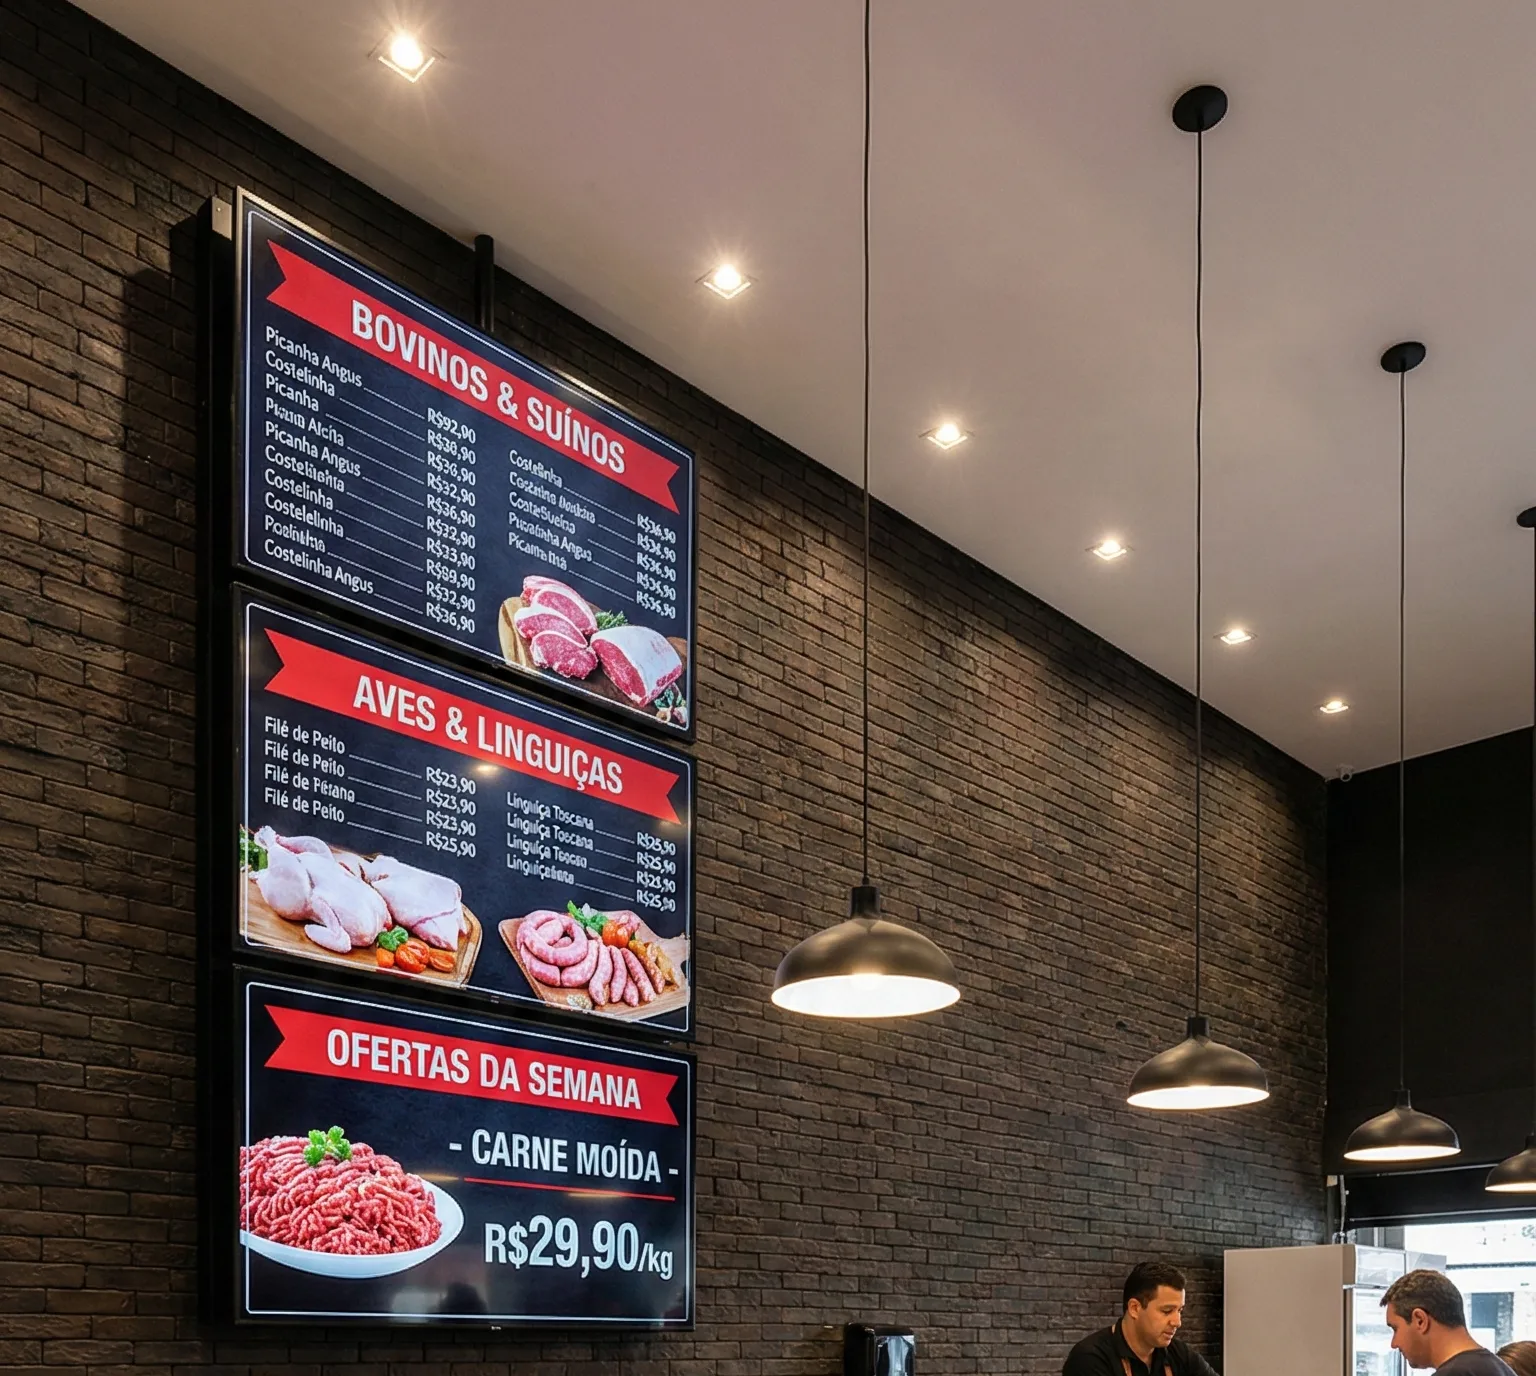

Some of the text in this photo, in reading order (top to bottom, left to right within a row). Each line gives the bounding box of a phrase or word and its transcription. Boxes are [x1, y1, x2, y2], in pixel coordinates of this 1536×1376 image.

[265, 350, 335, 396] Costelinha
[266, 326, 319, 366] Picanha
[322, 355, 362, 387] Angus
[352, 300, 625, 474] BOVINOS & SUÍNOS
[266, 373, 319, 412] Picanha
[265, 468, 333, 511] Costelinha
[266, 421, 318, 458] Picanha
[321, 446, 361, 477] Angus
[427, 493, 475, 528] R$36,90
[427, 472, 476, 507] R$32,90
[426, 515, 475, 549] R$32,90
[264, 539, 475, 633] Costelinha Angus R$36,90
[426, 580, 475, 613] R$32,90
[265, 715, 289, 738] Filé
[292, 724, 309, 744] de
[426, 766, 476, 795] R$23,90
[353, 675, 623, 794] AVES & LINGUIÇAS
[265, 739, 288, 761] Filé
[292, 748, 309, 767] de
[426, 788, 476, 816] R$23,90
[292, 771, 309, 791] de
[426, 809, 476, 837] R$23,90
[265, 786, 288, 808] Filé
[292, 795, 309, 814] de
[426, 831, 476, 858] R$25,90
[326, 1028, 642, 1110] OFERTAS DA SEMANA
[471, 1128, 568, 1173] CARNE
[576, 1138, 662, 1184] MOÍDA
[484, 1214, 674, 1280] R$29,90/kg
